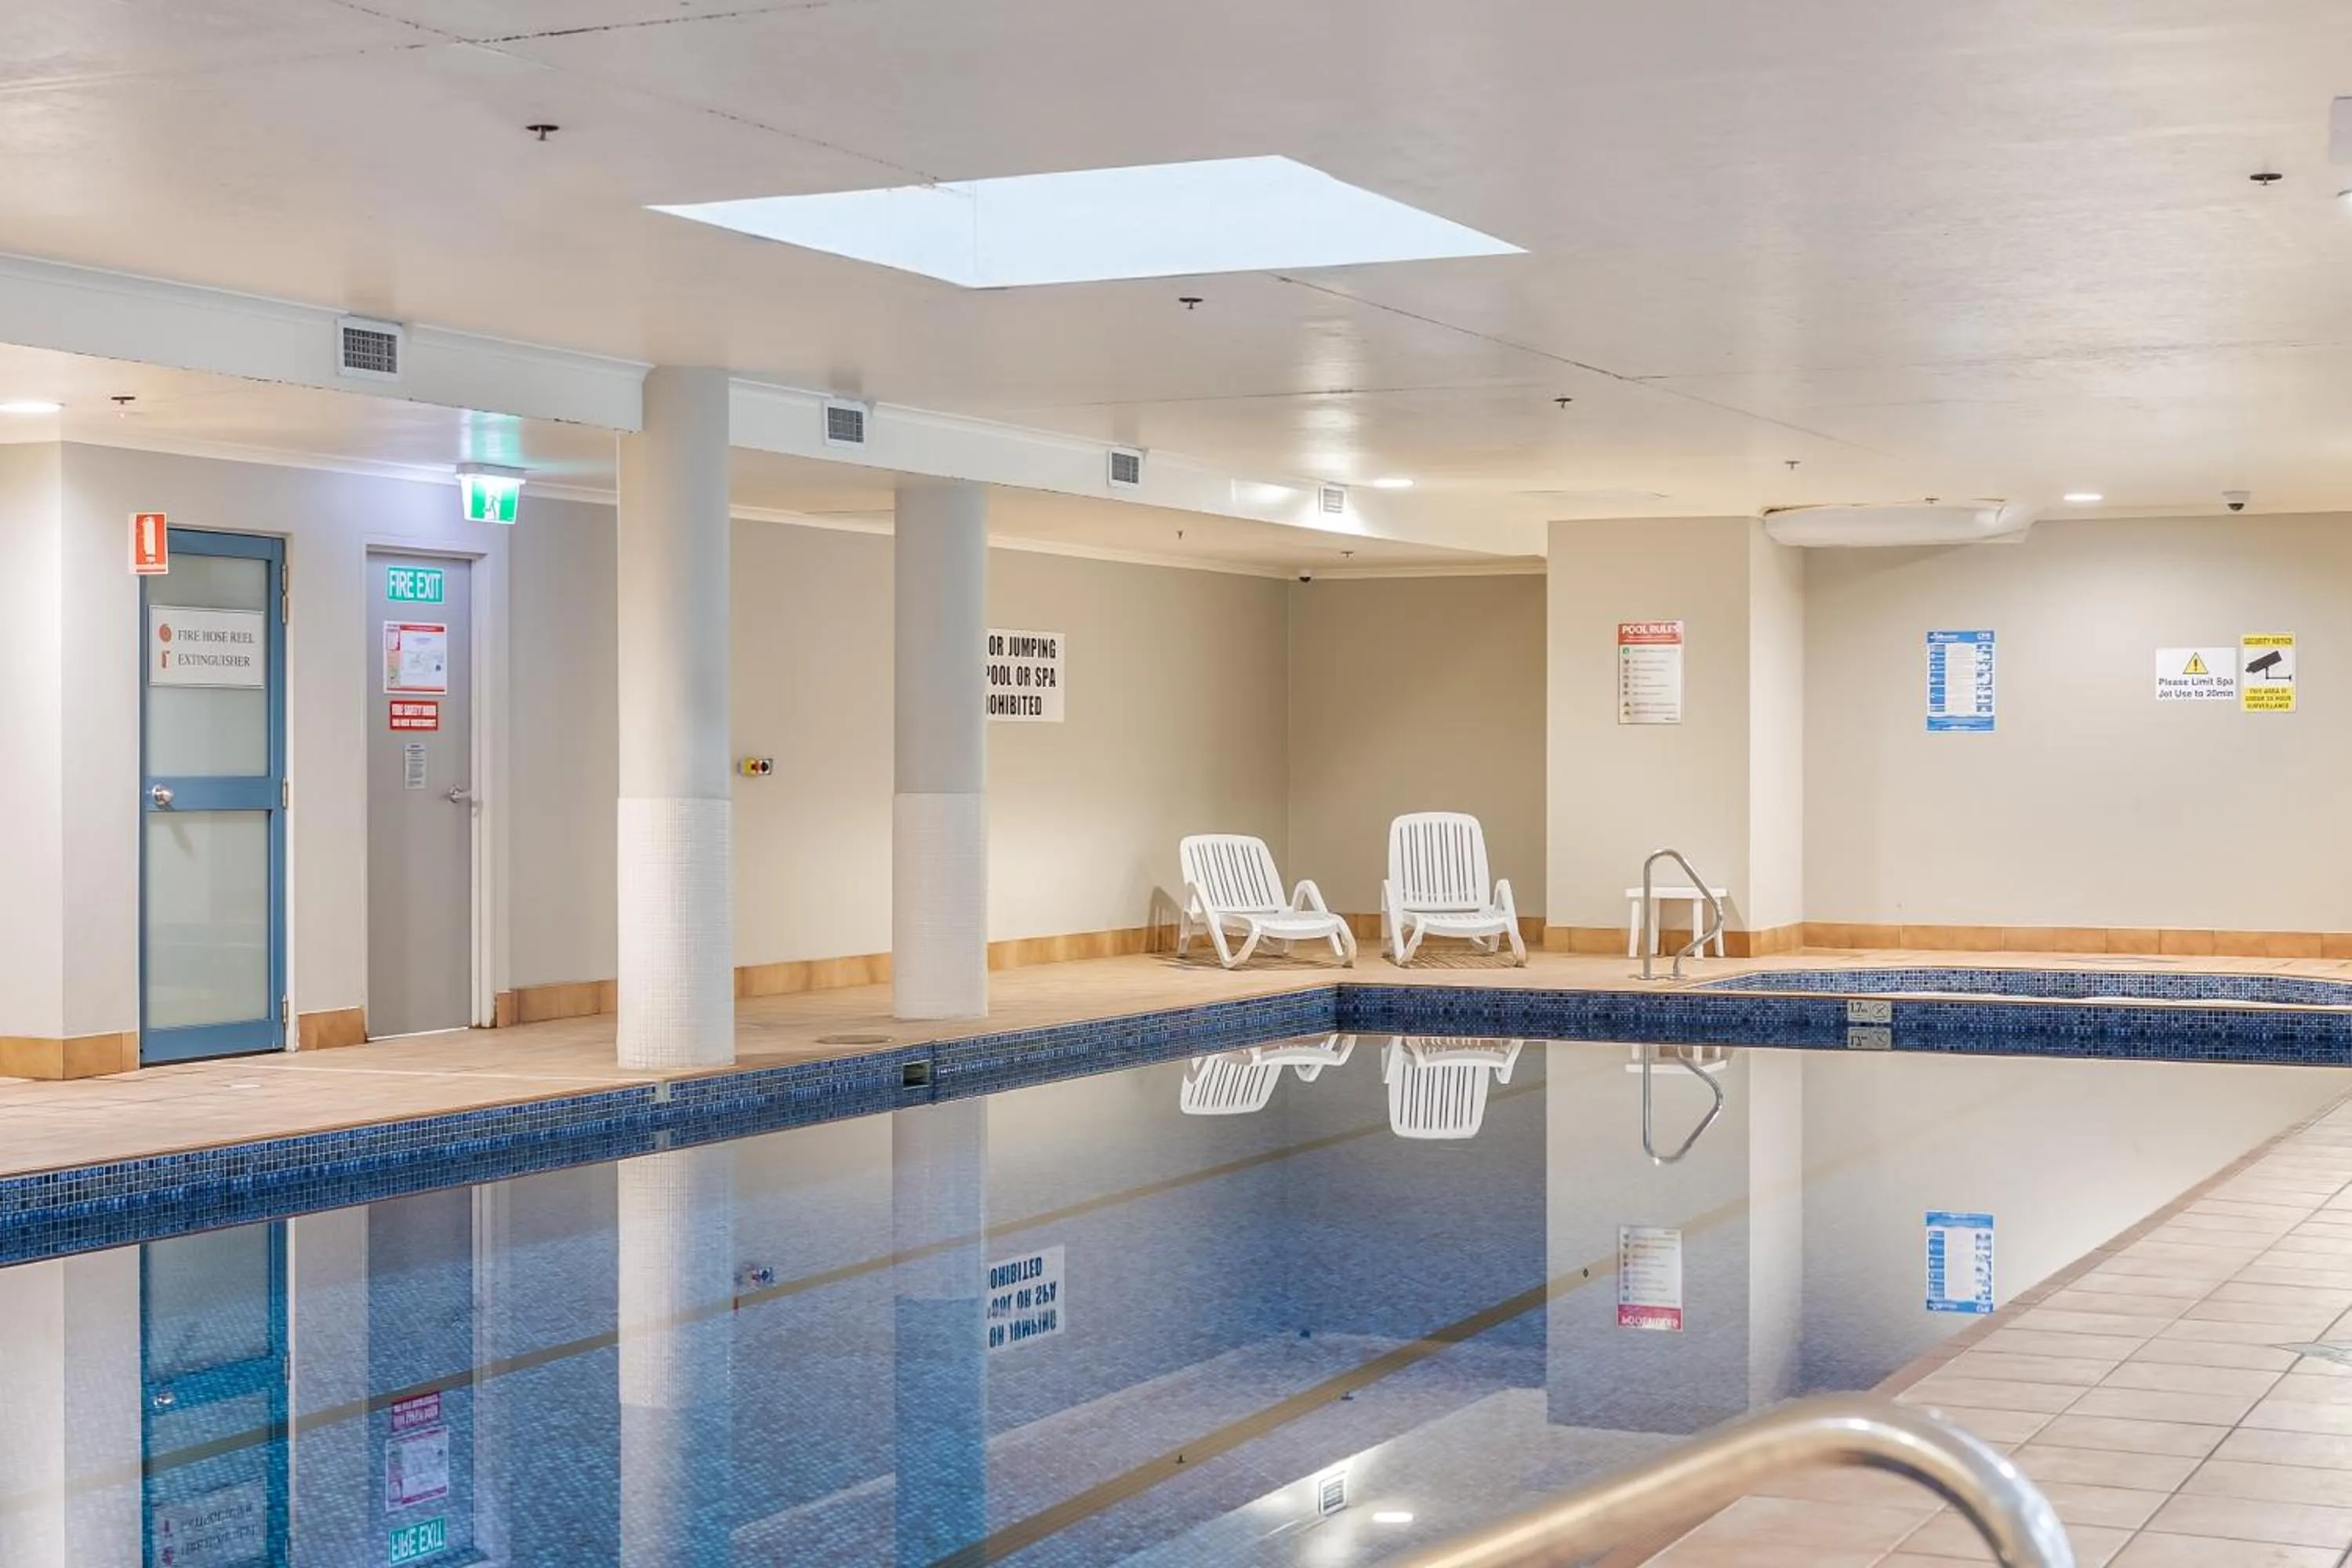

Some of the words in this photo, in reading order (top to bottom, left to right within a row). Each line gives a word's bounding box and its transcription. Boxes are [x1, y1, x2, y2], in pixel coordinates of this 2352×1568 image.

[389, 571, 414, 598] FIRE
[416, 572, 441, 600] EXIT
[1622, 625, 1648, 634] POOL
[178, 630, 201, 642] FIRE
[202, 630, 228, 643] HOSE
[230, 632, 256, 644] REEL
[989, 634, 1004, 656] OR
[1008, 636, 1056, 659] JUMPING
[178, 653, 251, 667] EXTINGUISHER
[1016, 666, 1031, 687] OR
[1035, 666, 1056, 688] SPA
[2158, 677, 2189, 686] Please
[2191, 677, 2213, 686] Limit
[2216, 677, 2234, 687] Spa
[2175, 690, 2193, 699] Use
[2206, 689, 2234, 698] 20min
[986, 694, 1042, 716] OHIBITED
